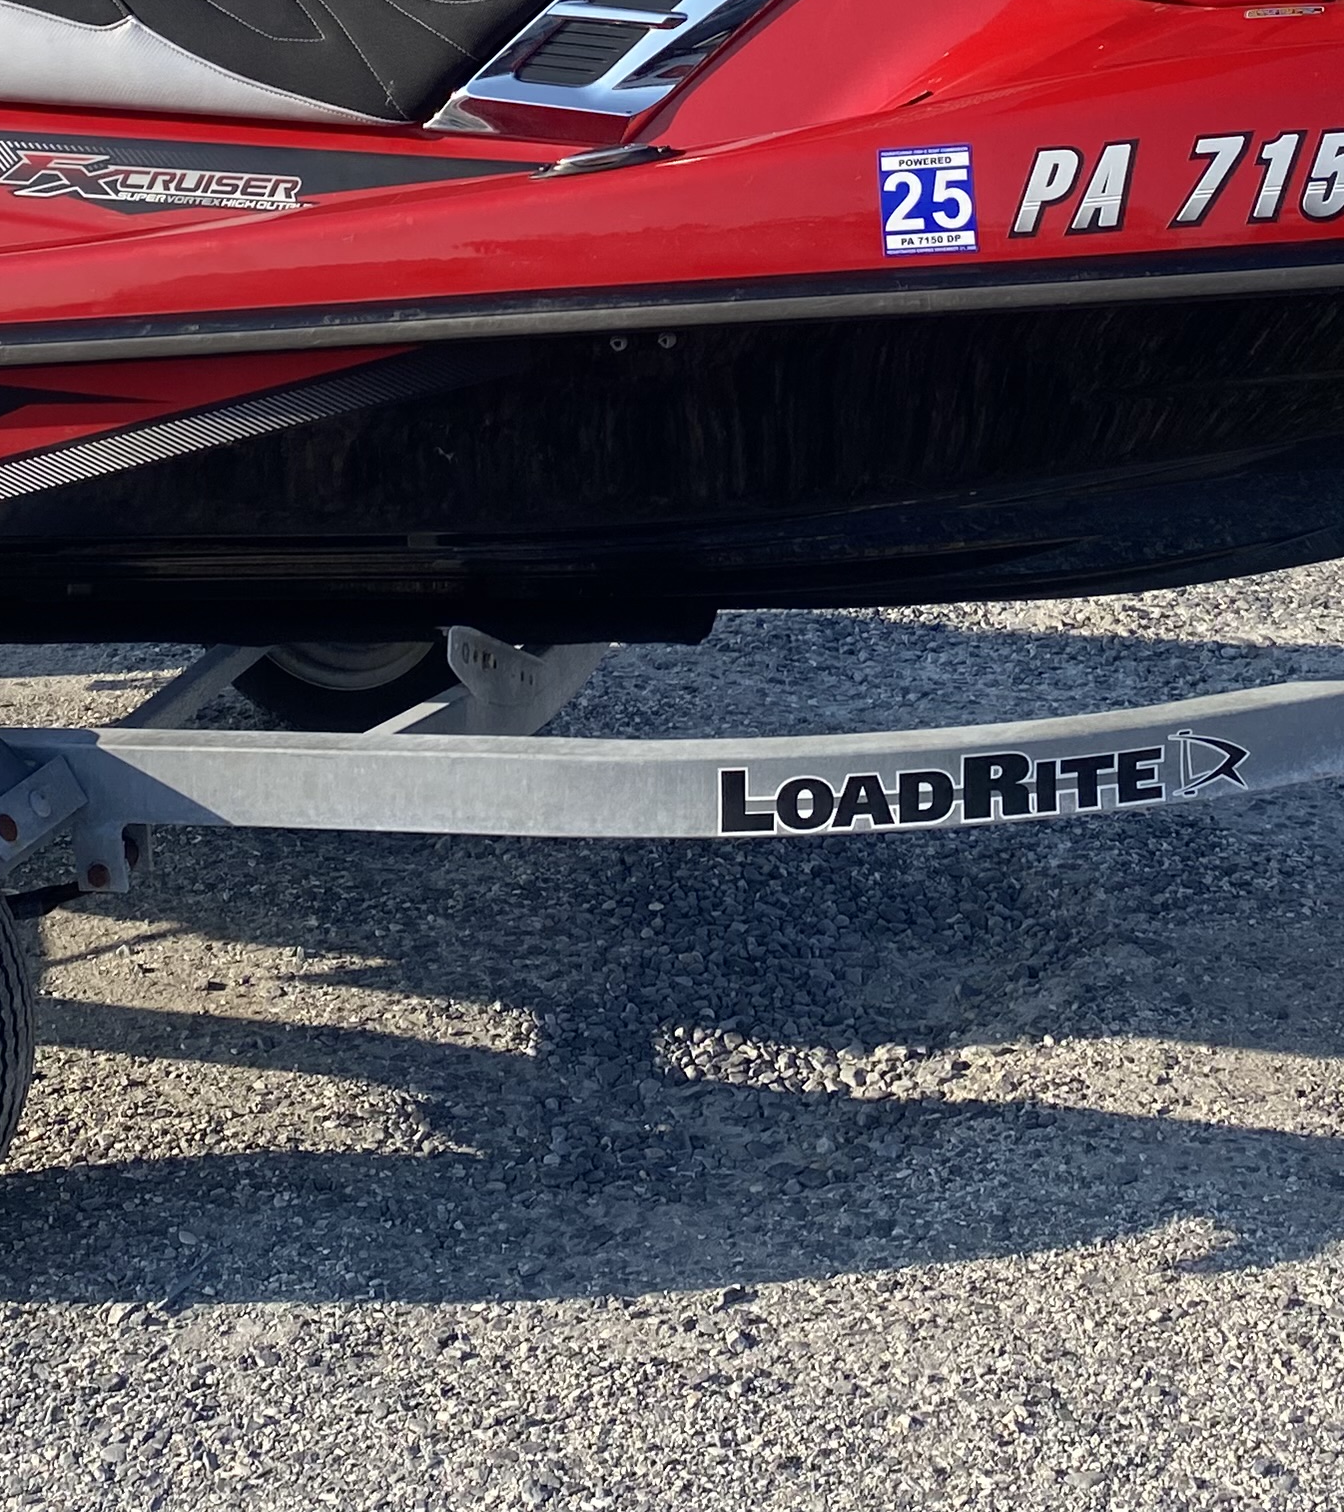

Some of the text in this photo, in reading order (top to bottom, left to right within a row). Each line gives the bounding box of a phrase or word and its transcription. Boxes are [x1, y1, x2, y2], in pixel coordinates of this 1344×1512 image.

[899, 156, 952, 167] POWERED
[1008, 140, 1139, 238] PA
[117, 191, 166, 204] SUPER
[166, 194, 222, 207] VORTEX
[221, 197, 256, 209] HIGH
[883, 168, 973, 232] 25
[901, 234, 962, 246] PA 7150 DP
